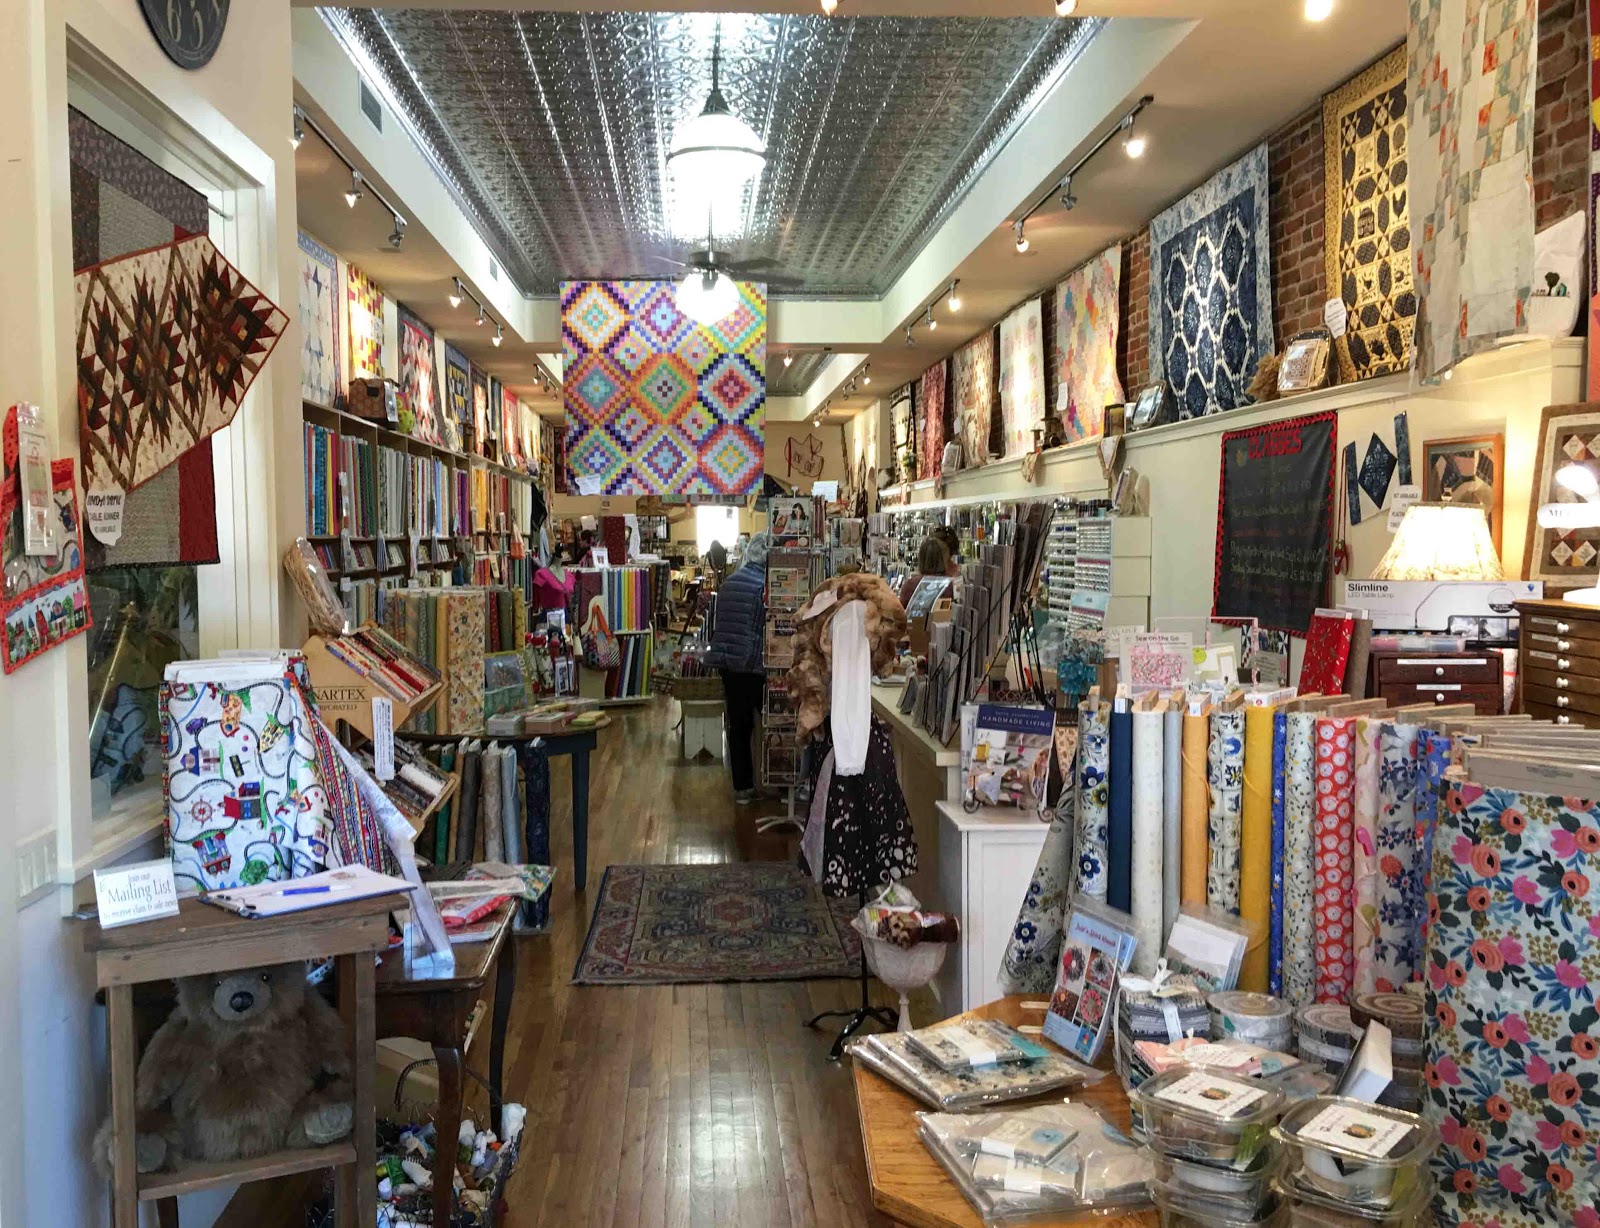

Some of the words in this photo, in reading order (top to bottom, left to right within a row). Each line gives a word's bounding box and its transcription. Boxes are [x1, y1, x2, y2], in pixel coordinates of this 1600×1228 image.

[1347, 583, 1389, 592] Slimline
[982, 715, 1023, 725] HANDMADE
[1025, 720, 1052, 728] LIVING
[108, 881, 153, 904] Mailing
[152, 879, 171, 895] List
